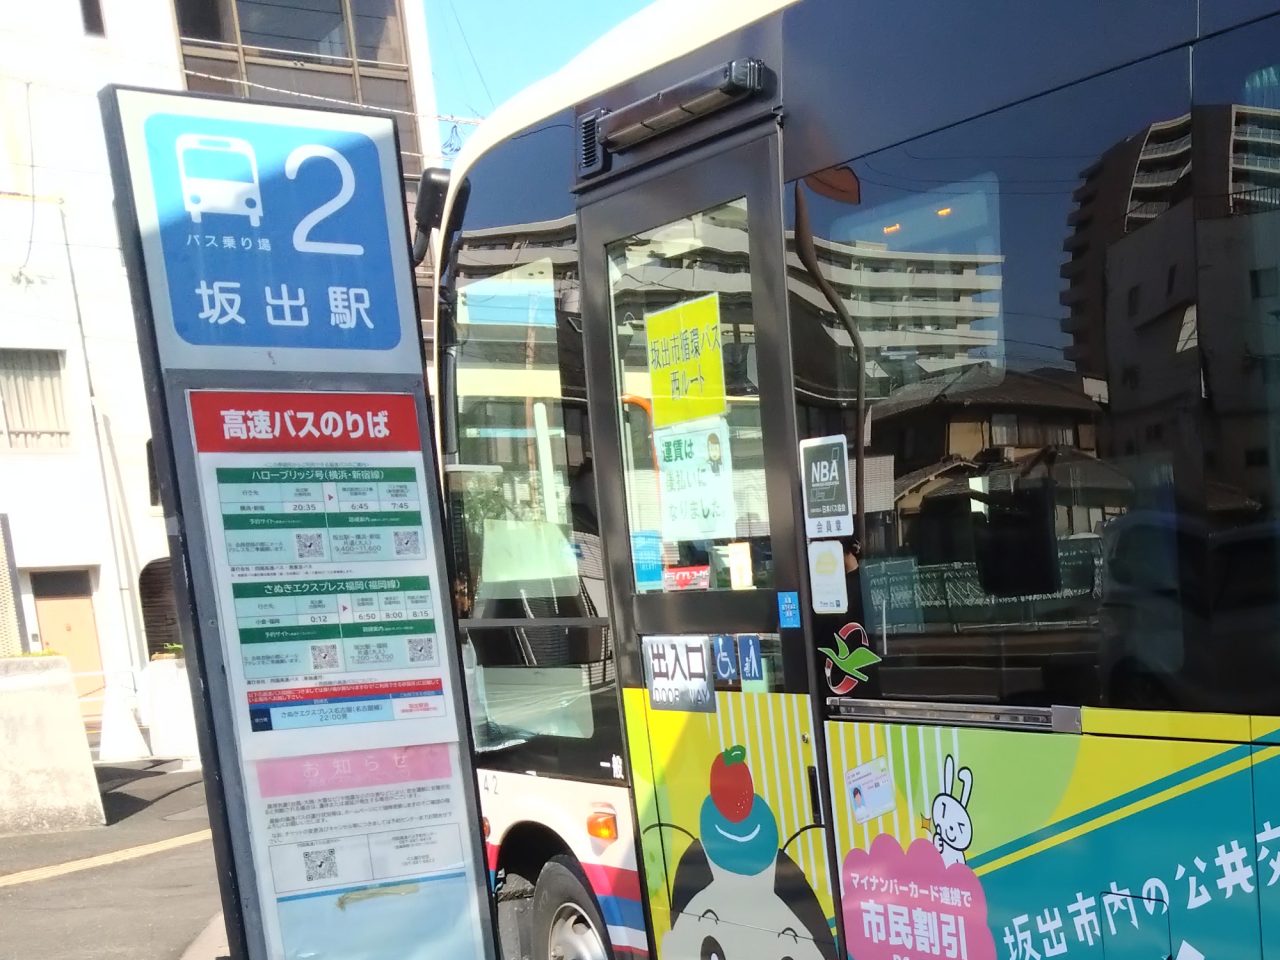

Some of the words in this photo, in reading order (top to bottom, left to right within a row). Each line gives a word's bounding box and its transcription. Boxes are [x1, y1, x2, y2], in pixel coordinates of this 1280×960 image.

[285, 144, 364, 255] 2
[187, 233, 271, 251] バス乗り場
[195, 281, 374, 329] 坂出駅
[651, 325, 721, 369] 坂出市循環バス
[670, 364, 704, 400] 西ルート
[220, 410, 390, 439] 高速バスのりば
[662, 438, 694, 462] 運賃は
[811, 460, 839, 483] NBA
[310, 615, 328, 623] 0:12
[651, 643, 706, 681] 出入口
[303, 753, 409, 778] お知らせ
[600, 753, 625, 779] 一般
[850, 872, 971, 908] マイナンバーカード連携で
[860, 899, 968, 960] 市民割引
